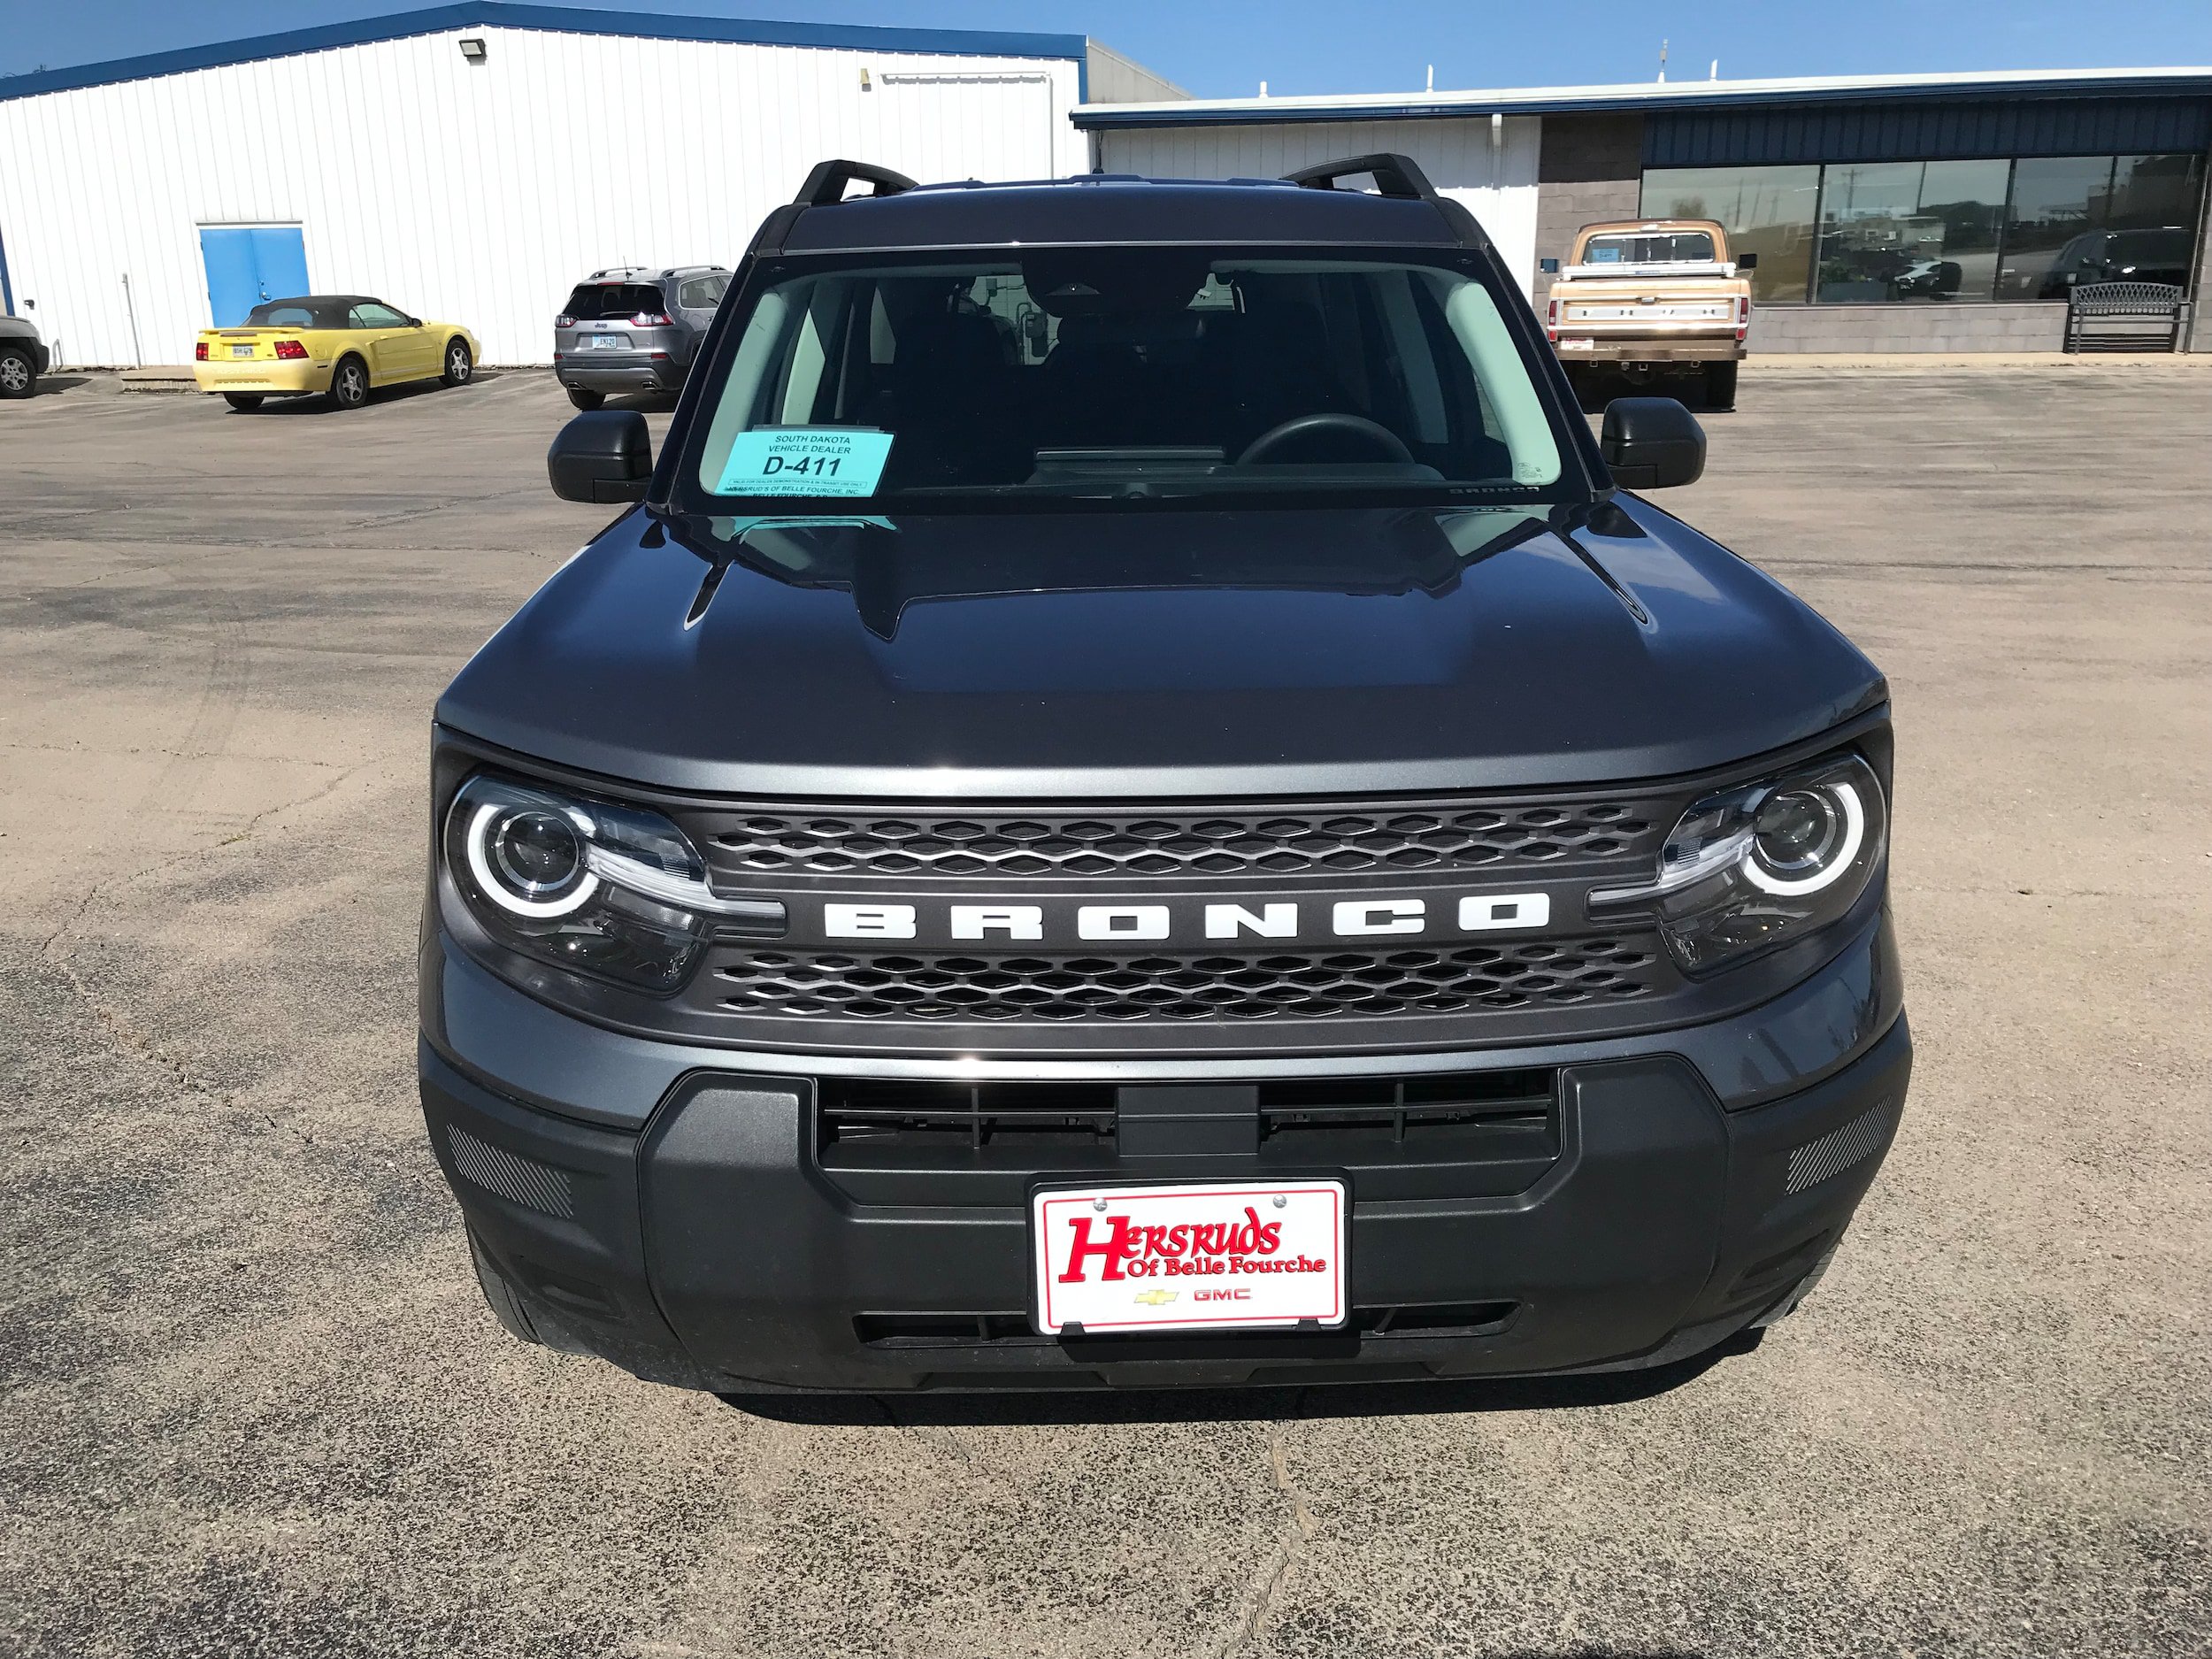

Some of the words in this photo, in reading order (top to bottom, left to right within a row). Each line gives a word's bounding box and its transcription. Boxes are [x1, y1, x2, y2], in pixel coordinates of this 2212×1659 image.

[810, 435, 851, 444] DAKOTA
[810, 445, 851, 455] DEALER
[762, 456, 841, 477] D-411
[824, 892, 1551, 941] BRONCO
[1127, 1257, 1161, 1278] Of
[1164, 1256, 1225, 1276] Belle
[1228, 1255, 1327, 1274] Fourche
[1194, 1288, 1252, 1302] GMC
